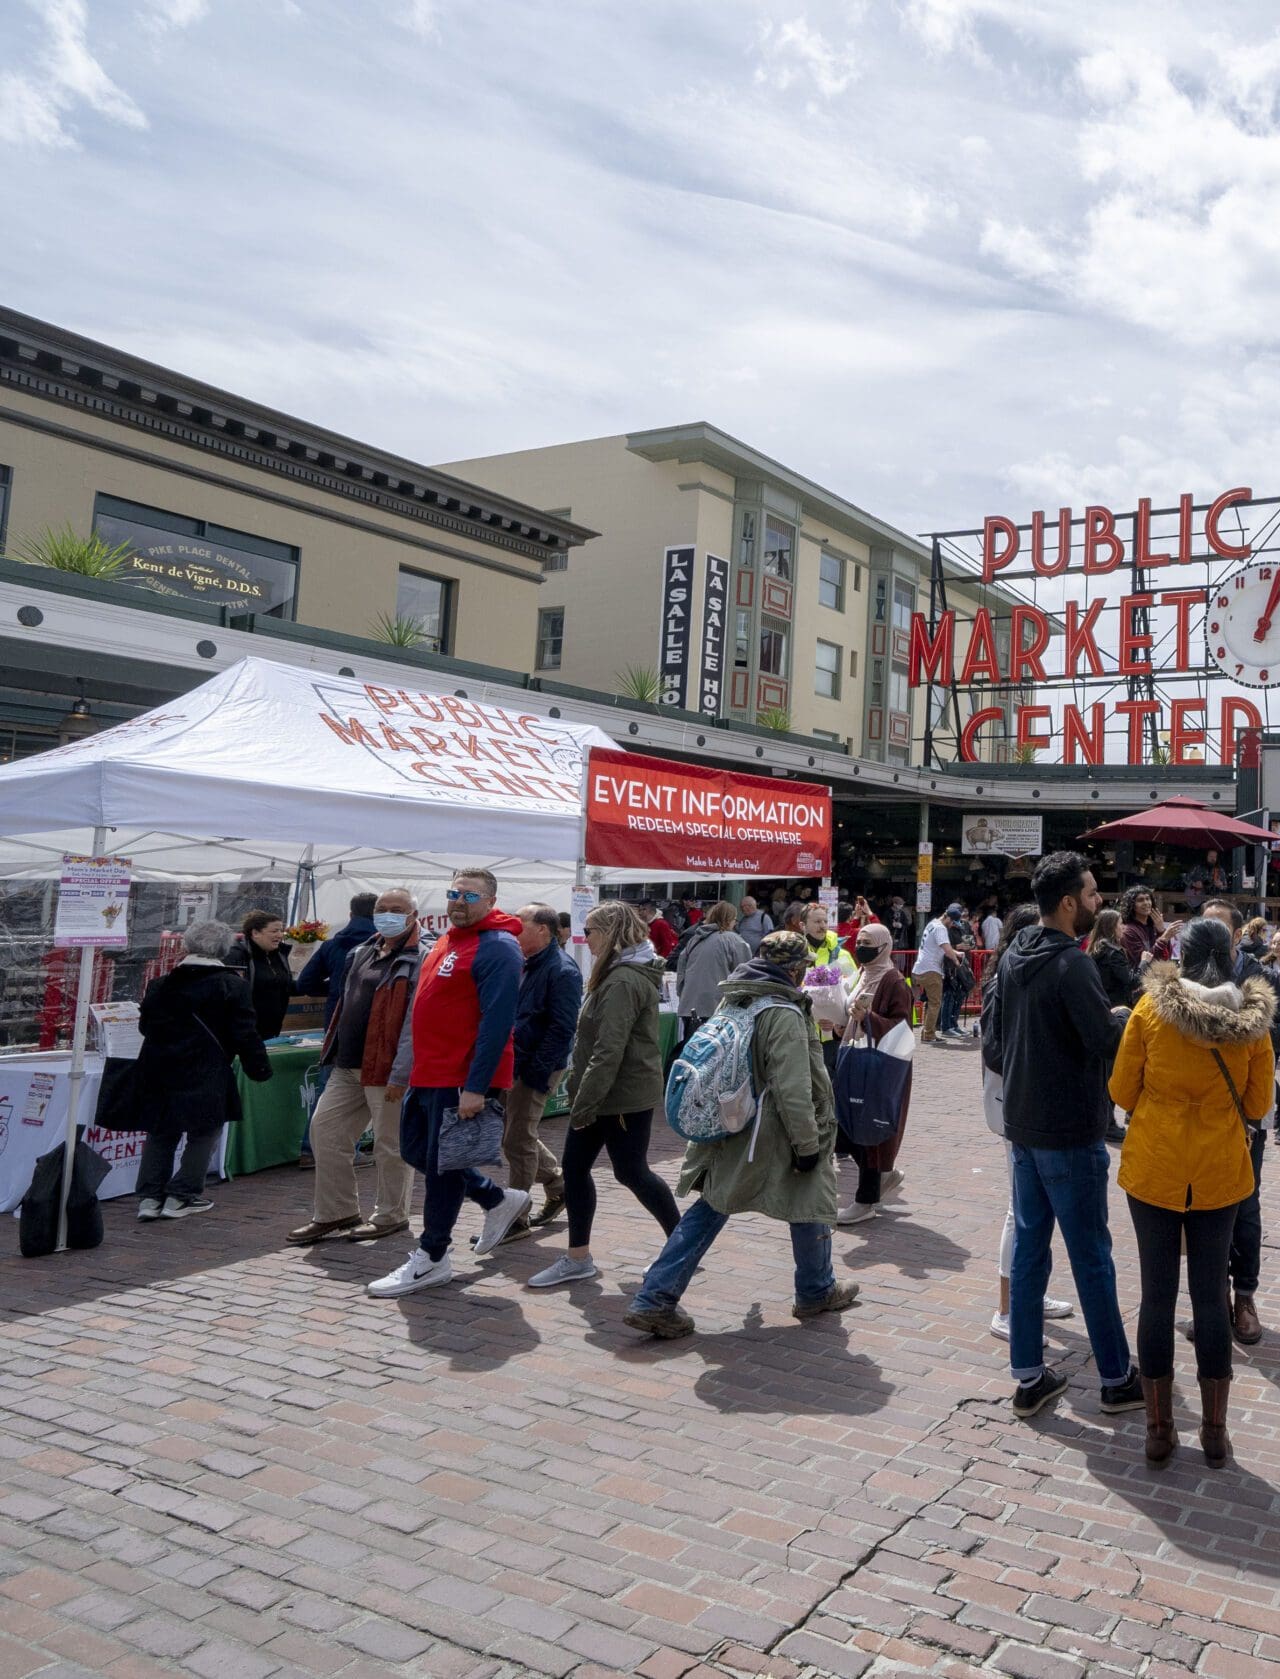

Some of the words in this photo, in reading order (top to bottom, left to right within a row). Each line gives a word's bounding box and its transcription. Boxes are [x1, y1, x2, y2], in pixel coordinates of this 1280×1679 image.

[981, 487, 1253, 584] PUBLIC
[132, 557, 164, 574] Kent
[168, 566, 184, 578] de
[226, 579, 262, 597] D.D.S.
[147, 545, 172, 557] PIKE
[178, 545, 212, 559] PLACE
[215, 554, 251, 579] DENTAL
[669, 553, 688, 582] LA
[709, 559, 724, 591] LA
[1259, 568, 1272, 580] 12
[1235, 577, 1245, 589] 11
[1217, 597, 1228, 608] 10
[666, 588, 687, 665] SALLE
[704, 597, 722, 672] SALLE
[908, 590, 1207, 688] MARKET
[1211, 622, 1219, 633] 9
[1217, 647, 1225, 659] 8
[1235, 664, 1244, 675] 7
[1259, 669, 1268, 681] 6
[363, 684, 559, 745] PUBLIC
[318, 713, 554, 774] MARKET
[594, 775, 677, 812] EVENT
[682, 788, 824, 828] INFORMATION
[627, 814, 685, 835] REDEEM
[686, 822, 736, 840] SPECIAL
[737, 827, 774, 843] OFFER
[775, 831, 802, 845] HERE
[686, 855, 707, 866] Make
[715, 858, 722, 868] A
[723, 858, 743, 870] Market
[437, 914, 449, 929] IT
[100, 1140, 145, 1161] CENT
